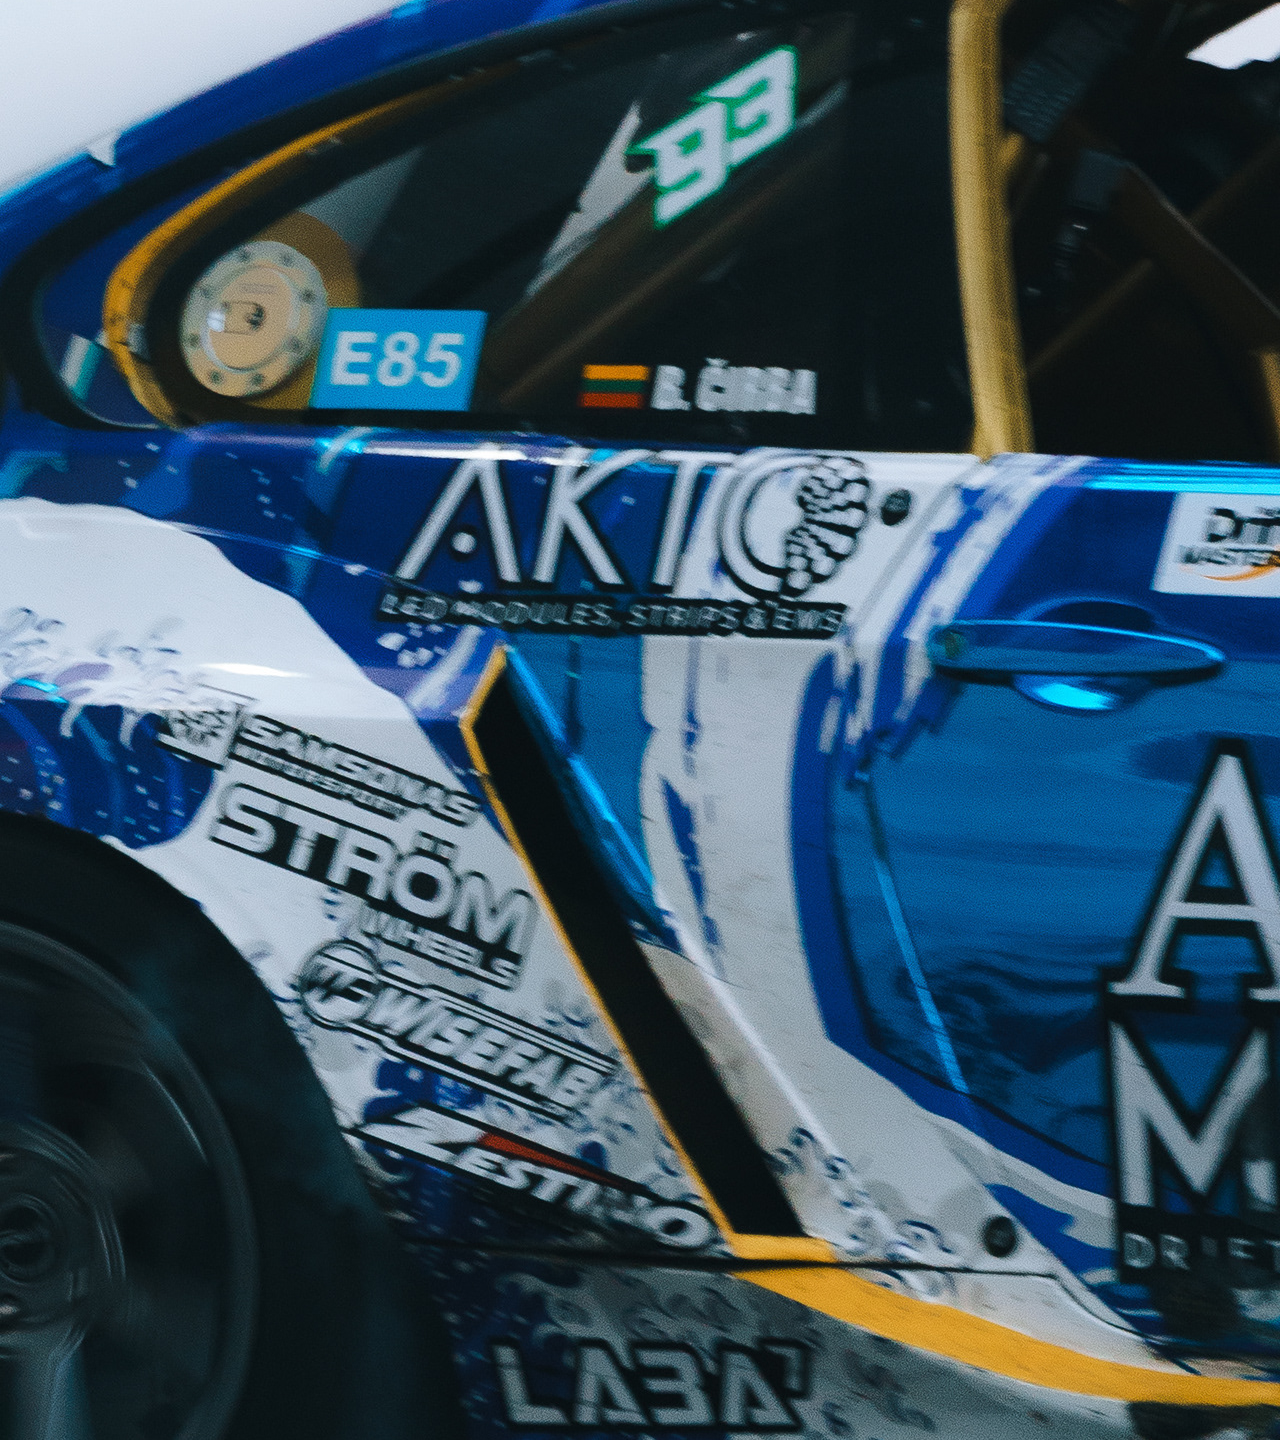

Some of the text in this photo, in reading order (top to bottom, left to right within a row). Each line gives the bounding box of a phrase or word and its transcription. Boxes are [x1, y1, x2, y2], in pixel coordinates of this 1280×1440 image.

[643, 47, 796, 228] 93
[330, 331, 464, 388] E85
[210, 783, 534, 957] STRÖM
[358, 900, 524, 986] WHEELS
